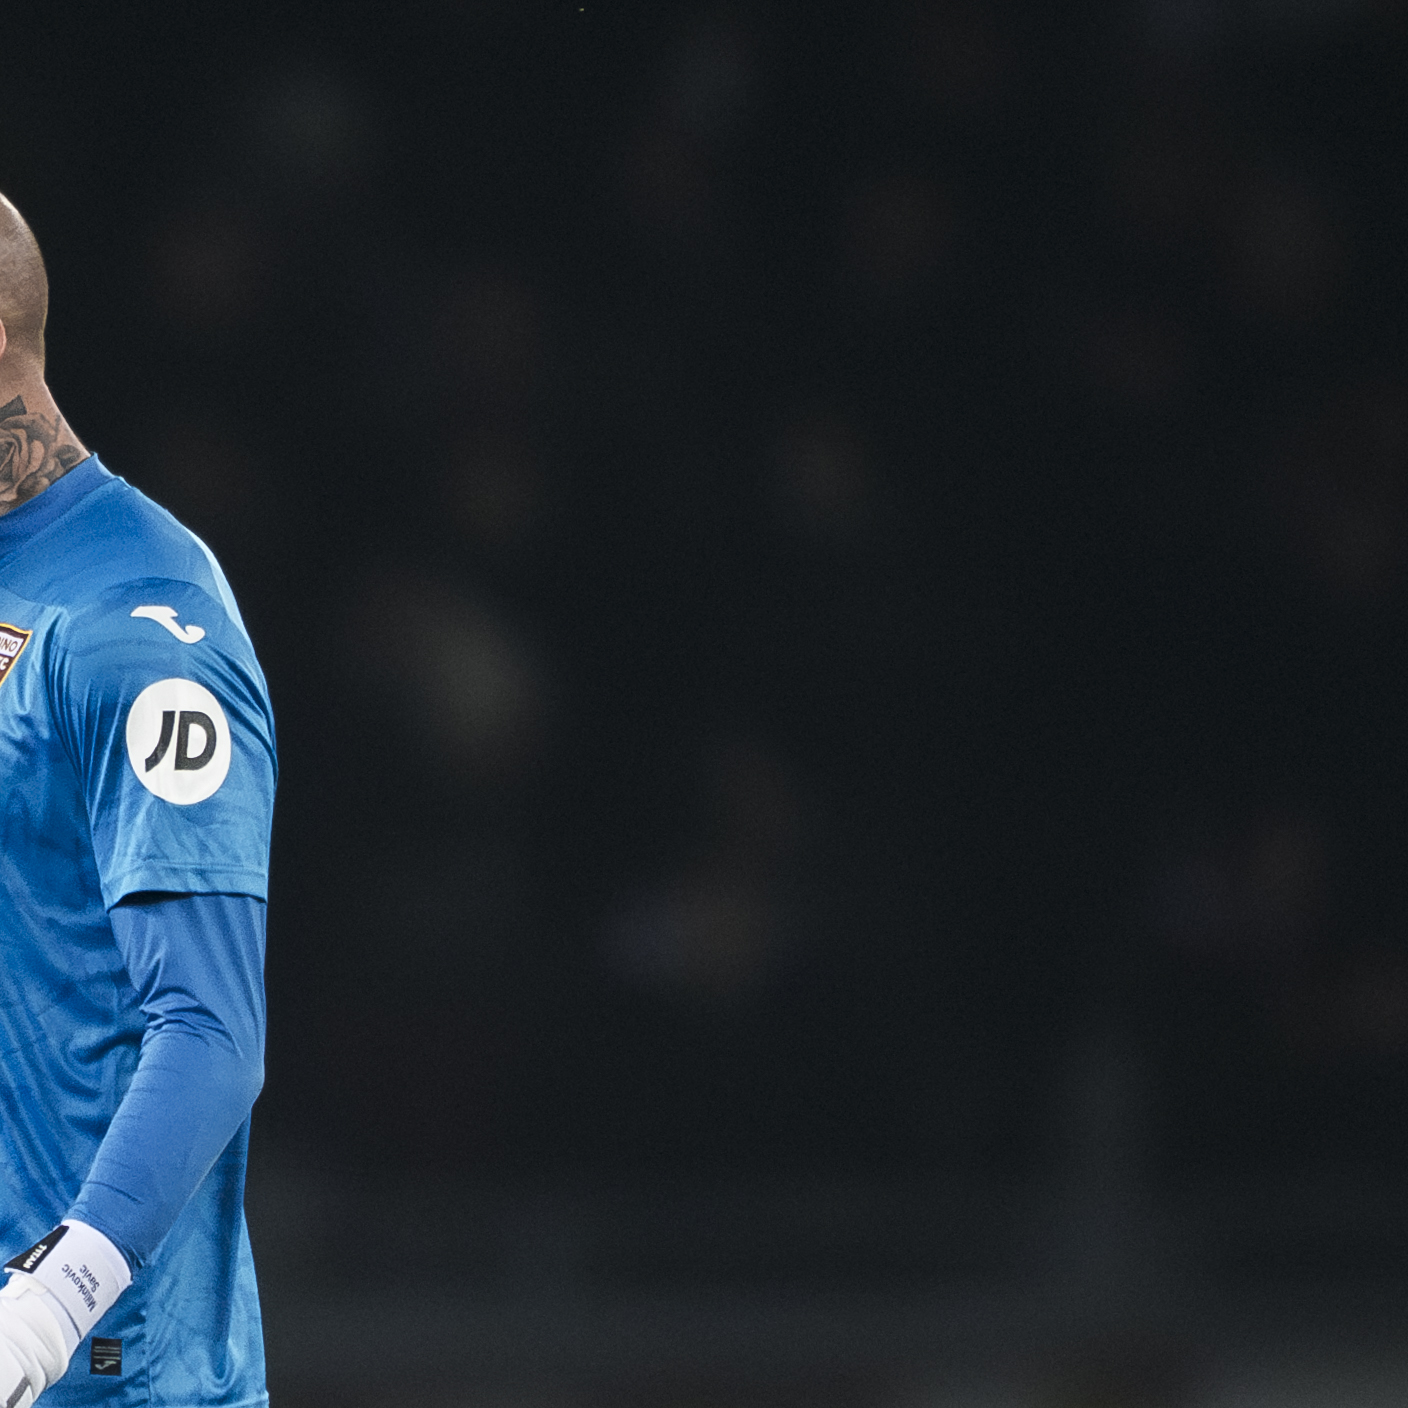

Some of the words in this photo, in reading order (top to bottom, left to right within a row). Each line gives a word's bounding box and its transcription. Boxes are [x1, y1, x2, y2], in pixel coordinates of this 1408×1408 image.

[144, 710, 217, 773] JD
[22, 1243, 48, 1270] TITAN
[79, 1264, 100, 1294] Savic
